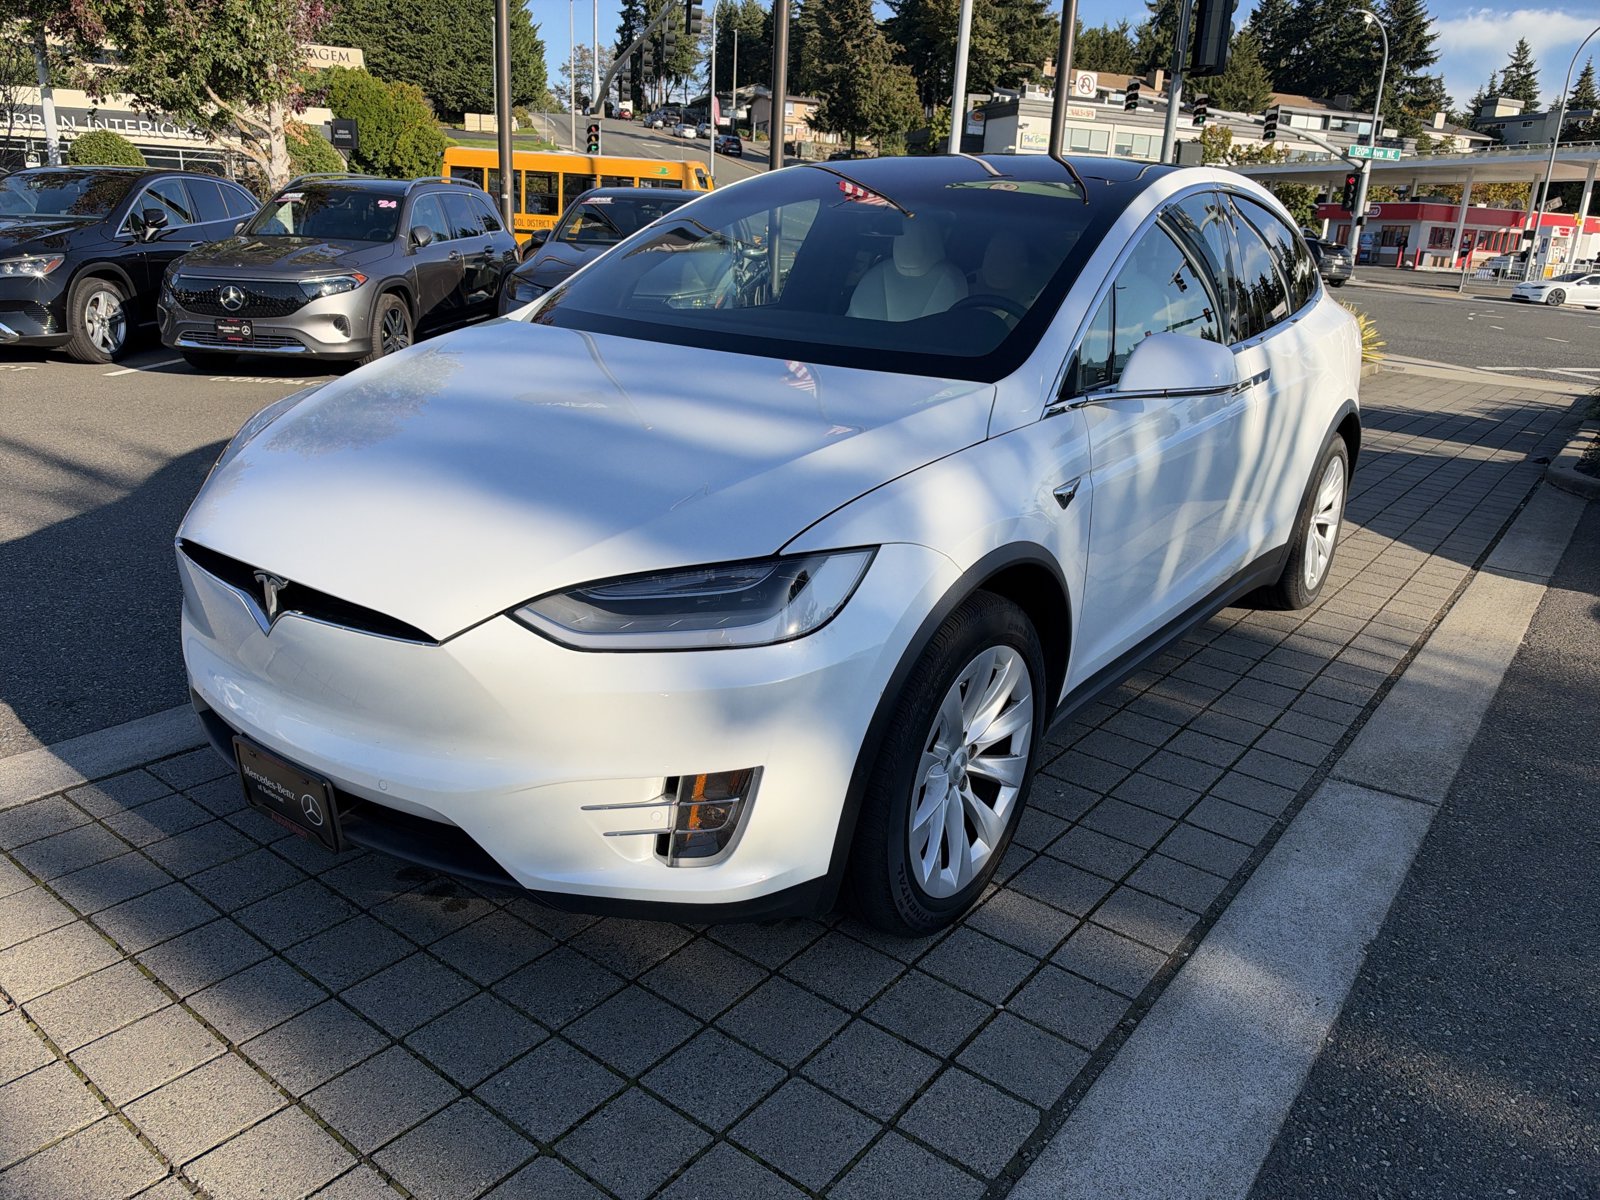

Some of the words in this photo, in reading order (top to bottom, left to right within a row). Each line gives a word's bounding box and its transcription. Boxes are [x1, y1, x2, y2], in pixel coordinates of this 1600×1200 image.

[0, 110, 76, 131] URBN
[1373, 149, 1384, 158] Ave
[1387, 150, 1396, 159] NE
[527, 219, 550, 228] DISTRICT
[243, 764, 296, 801] Mercedes-Benz
